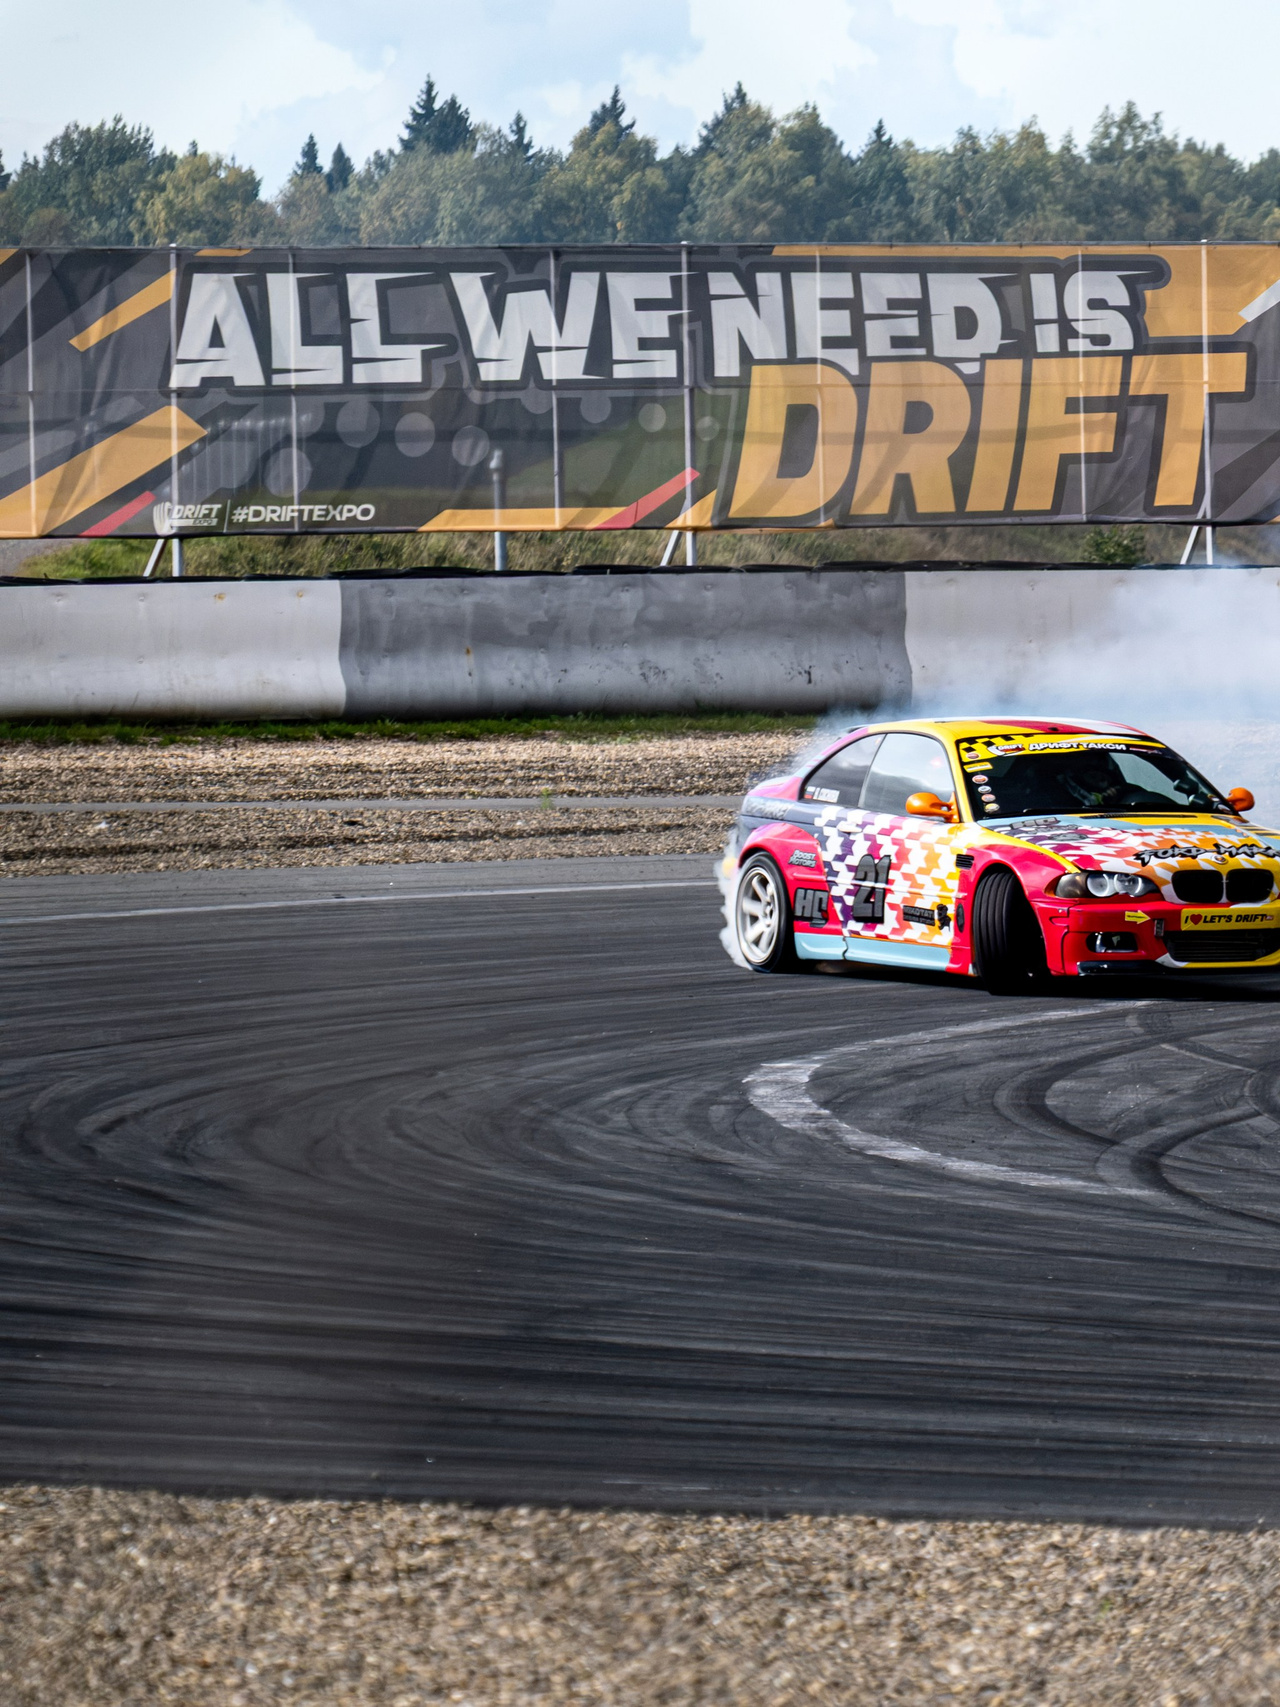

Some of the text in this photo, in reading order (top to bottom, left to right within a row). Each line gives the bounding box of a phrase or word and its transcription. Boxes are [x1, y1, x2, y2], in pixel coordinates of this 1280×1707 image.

[168, 270, 1156, 388] ALL WE NEED IS
[727, 351, 1248, 519] DRIFT
[171, 503, 222, 519] DRIFT
[231, 503, 376, 523] #DRIFTEXPO
[1028, 742, 1127, 751] ДРИФТ ТАКСИ
[853, 854, 892, 923] 21
[1184, 914, 1267, 924] I LET'S DRIFT
